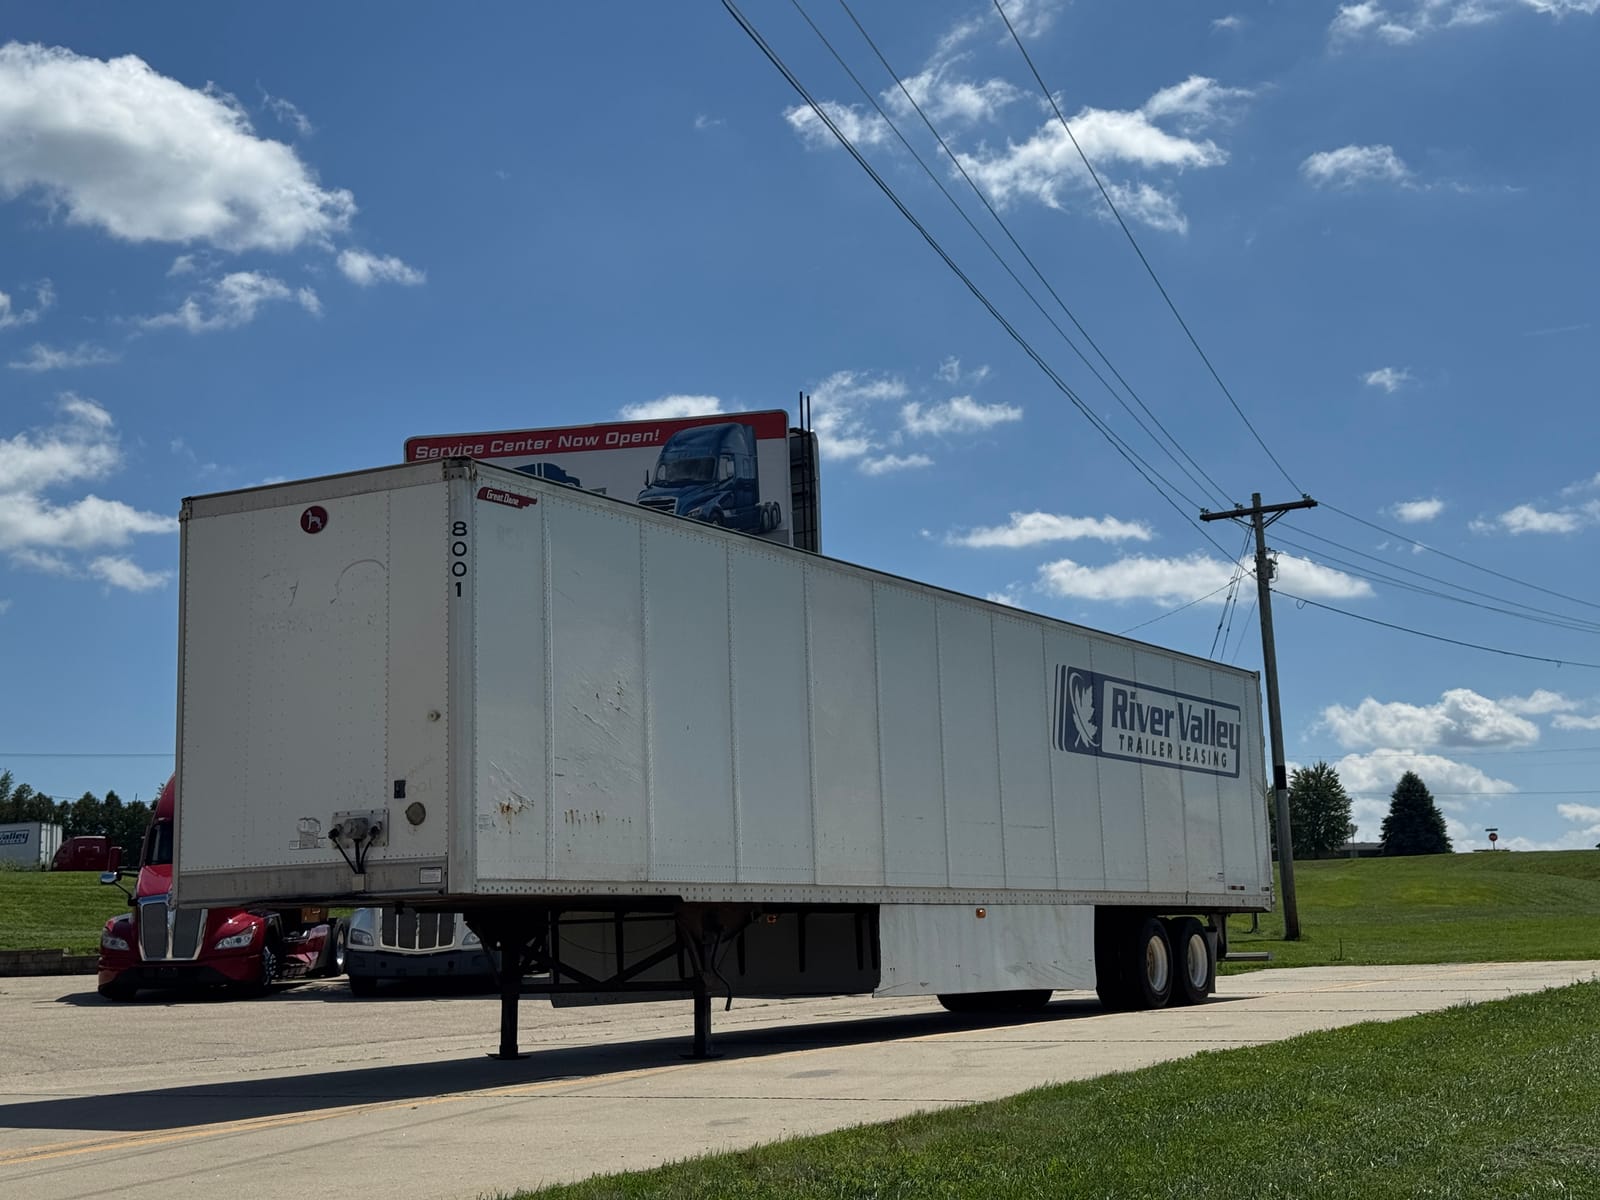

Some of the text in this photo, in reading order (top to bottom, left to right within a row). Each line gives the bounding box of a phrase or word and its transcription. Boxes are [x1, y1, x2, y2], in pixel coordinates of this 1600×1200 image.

[415, 429, 660, 459] Service Center Now Open!
[486, 489, 520, 506] Great Dane
[452, 521, 467, 597] 8001
[1111, 687, 1241, 750] River Valley
[1119, 734, 1227, 768] TRAILER LEASING
